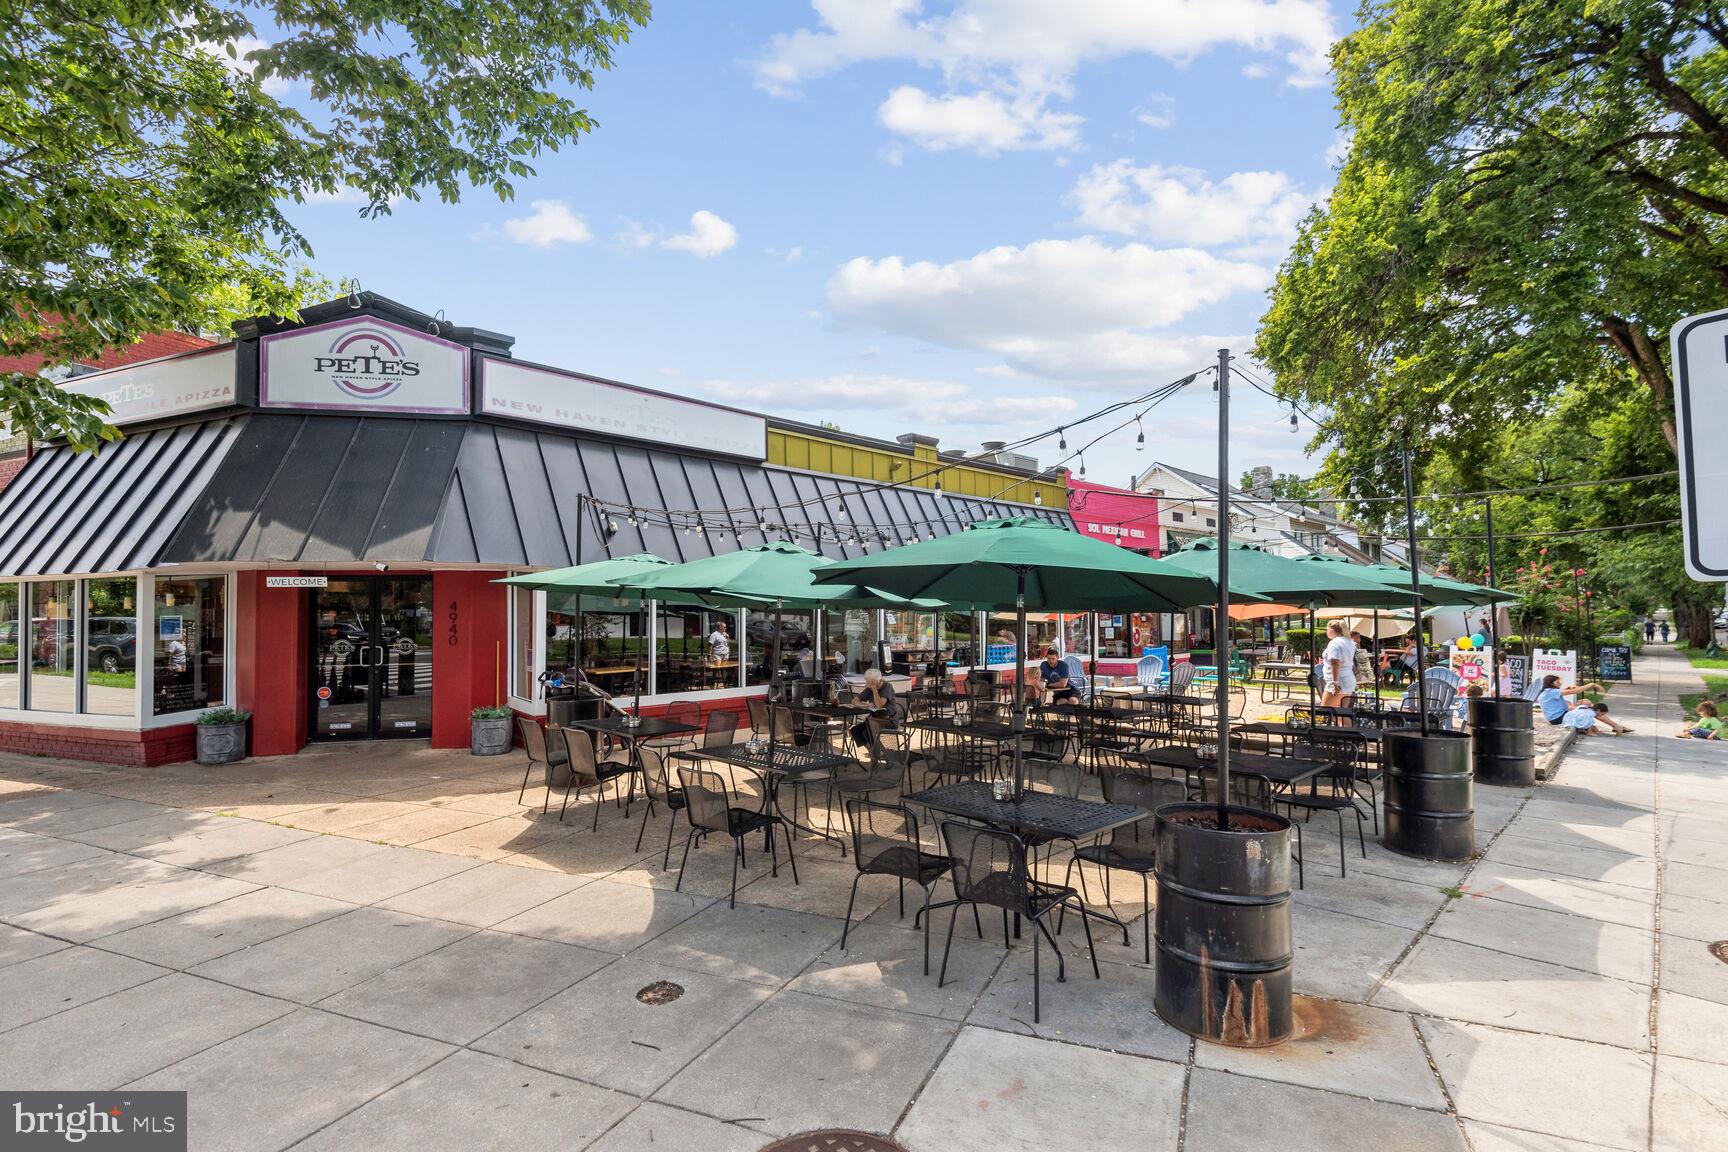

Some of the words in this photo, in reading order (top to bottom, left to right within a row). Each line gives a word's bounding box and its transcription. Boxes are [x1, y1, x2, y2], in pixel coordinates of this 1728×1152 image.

[314, 356, 420, 376] PETE'S
[175, 386, 232, 404] APIZZA
[491, 397, 543, 414] NEW
[554, 409, 627, 429] HAVEN
[635, 423, 695, 440] STYLE
[1088, 523, 1100, 533] SOL
[1130, 529, 1146, 539] GRILL
[270, 577, 323, 586] WELCOME
[448, 601, 458, 646] 4940
[1536, 664, 1573, 672] TUESDAY
